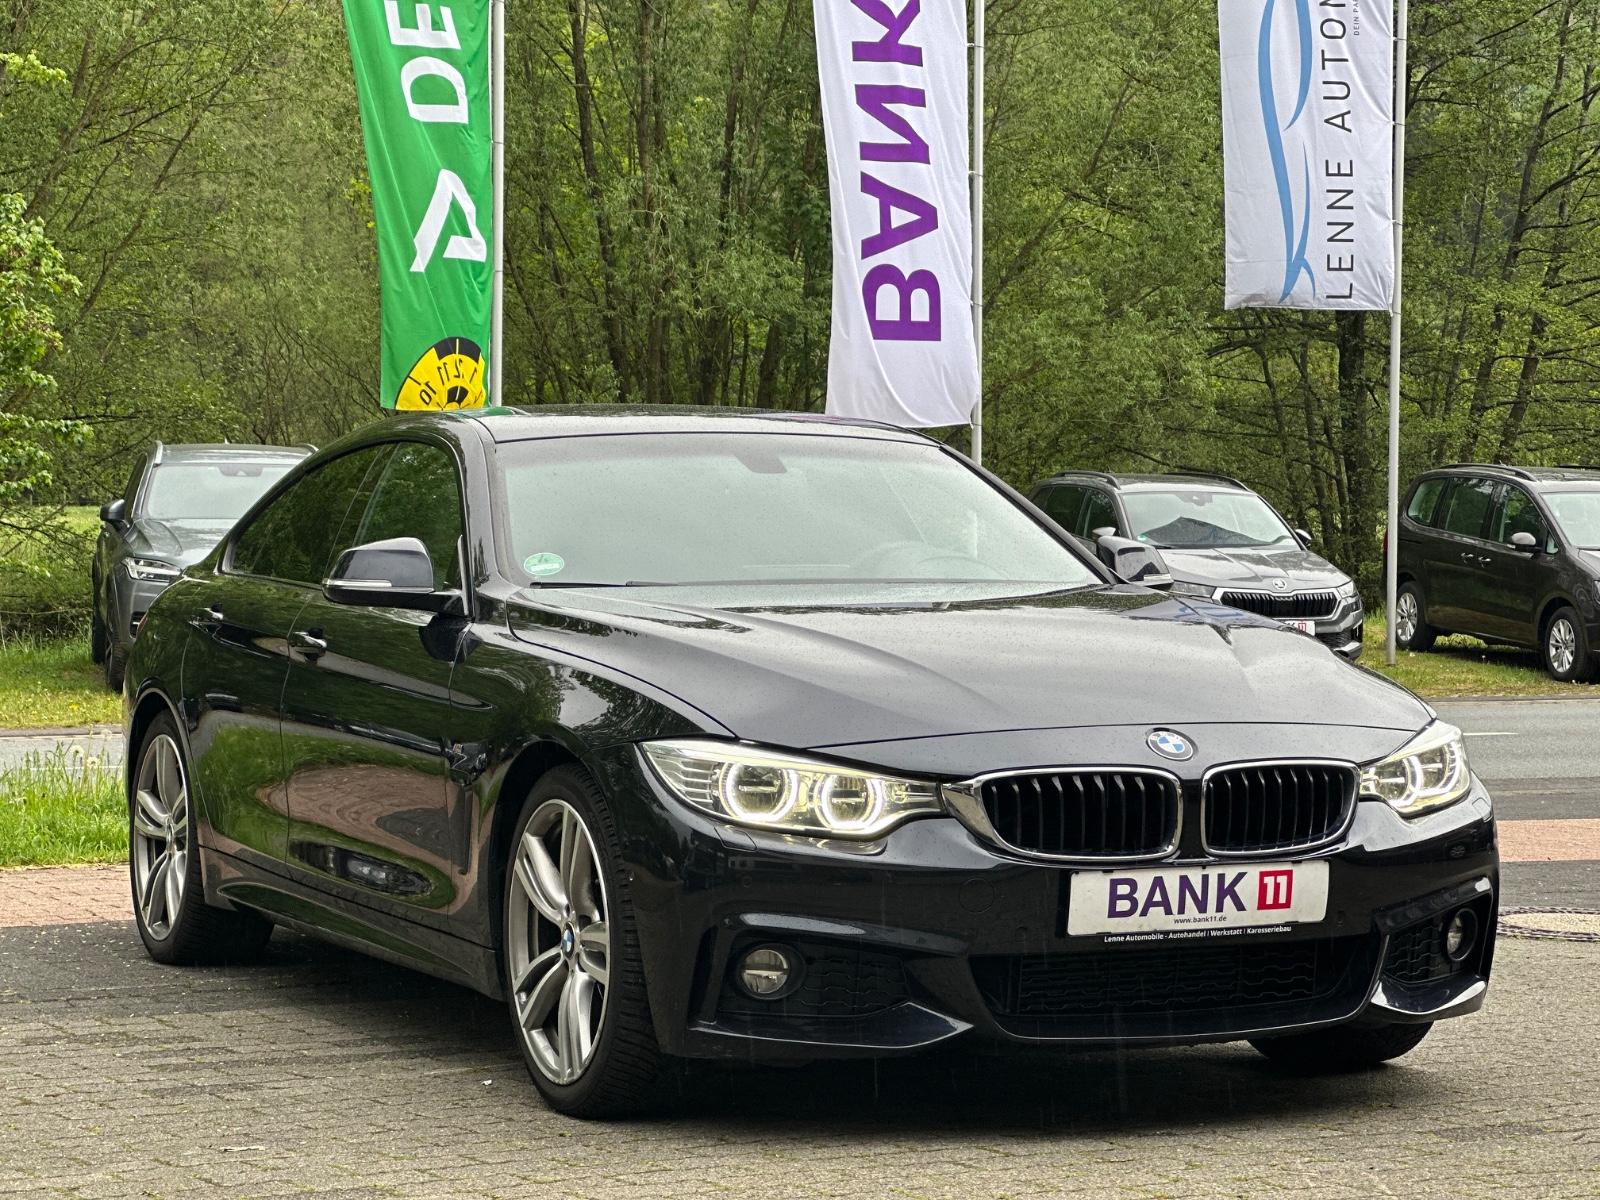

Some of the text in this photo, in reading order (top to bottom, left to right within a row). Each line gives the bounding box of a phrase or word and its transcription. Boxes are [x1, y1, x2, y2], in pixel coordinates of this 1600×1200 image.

[1319, 0, 1355, 300] LENNE AUTO
[1107, 871, 1289, 919] BANK 11
[1103, 935, 1125, 943] Lenne
[1125, 932, 1164, 942] Automobile
[1168, 929, 1207, 939] Autohandel
[1210, 927, 1243, 938] Werkstatt
[1246, 925, 1292, 935] Karosseriebau
[1173, 915, 1227, 925] www.bank11.de
